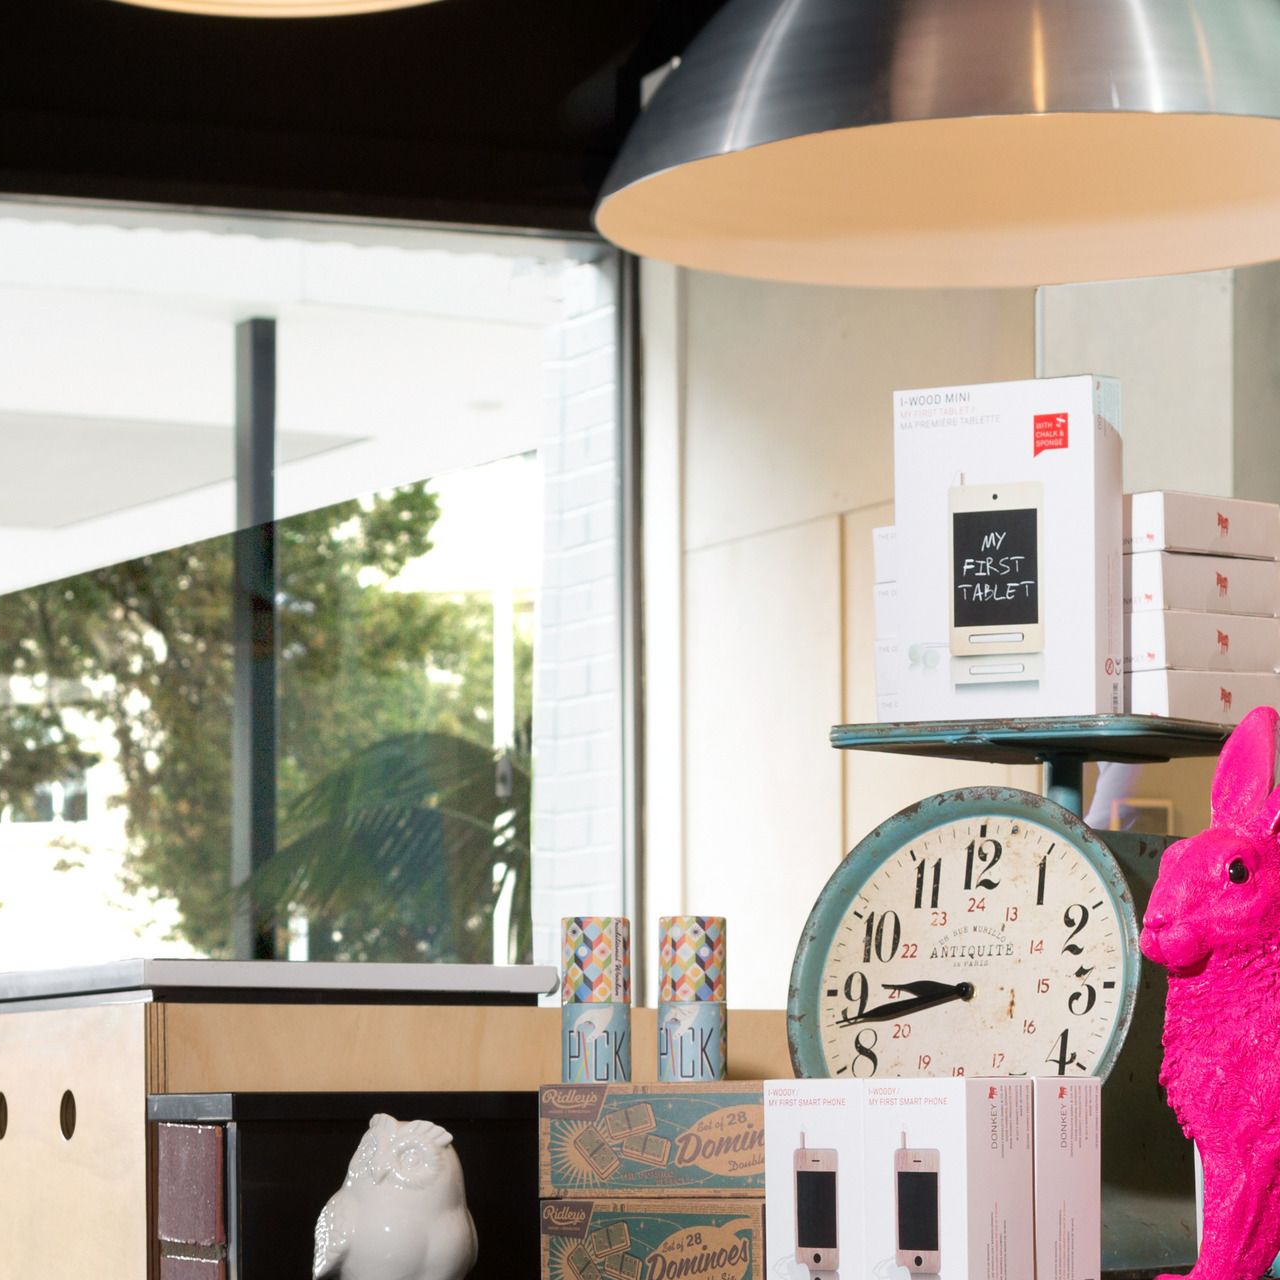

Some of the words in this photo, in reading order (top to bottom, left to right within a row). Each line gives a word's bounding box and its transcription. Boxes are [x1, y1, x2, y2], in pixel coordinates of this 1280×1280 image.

[900, 394, 942, 407] I-WOOD
[945, 391, 970, 404] MINI
[917, 408, 938, 419] FIRST
[939, 406, 970, 417] TABLET
[960, 414, 1000, 426] TABLETTE
[1036, 422, 1053, 430] WITH
[1036, 430, 1058, 438] CHALK
[1036, 438, 1062, 448] SPONGE
[981, 532, 1006, 552] MY
[962, 556, 1024, 576] FIRST
[958, 580, 1035, 602] TABLET
[964, 838, 1003, 890] 12
[914, 858, 942, 909] 11
[1036, 856, 1048, 905] 1
[968, 898, 986, 912] 24
[930, 912, 947, 926] 23
[1006, 907, 1018, 922] 13
[863, 910, 901, 963] 10
[1062, 904, 1089, 956] 2
[901, 944, 918, 959] 22
[1029, 940, 1044, 954] 14
[1037, 978, 1050, 994] 15
[1068, 966, 1096, 1016] 3
[841, 972, 870, 1024] 9
[892, 1024, 911, 1038] 20
[1023, 1020, 1036, 1034] 16
[852, 1028, 878, 1078] 8
[1045, 1028, 1077, 1076] 4
[918, 1055, 932, 1070] 19
[992, 1054, 1005, 1069] 17
[542, 1088, 598, 1110] Ridley's
[798, 1098, 822, 1106] SMART
[823, 1098, 846, 1106] PHONE
[869, 1098, 878, 1106] MY
[880, 1098, 898, 1106] FIRST
[899, 1098, 922, 1106] SMART
[924, 1097, 948, 1106] PHONE
[697, 1120, 712, 1132] Set
[714, 1117, 726, 1131] of
[726, 1112, 748, 1126] 28
[1060, 1104, 1068, 1148] DONKEY
[677, 1122, 765, 1165] Domin
[544, 1206, 586, 1226] Ridley's
[662, 1241, 674, 1253] Set
[677, 1239, 685, 1251] of
[686, 1232, 702, 1248] 28
